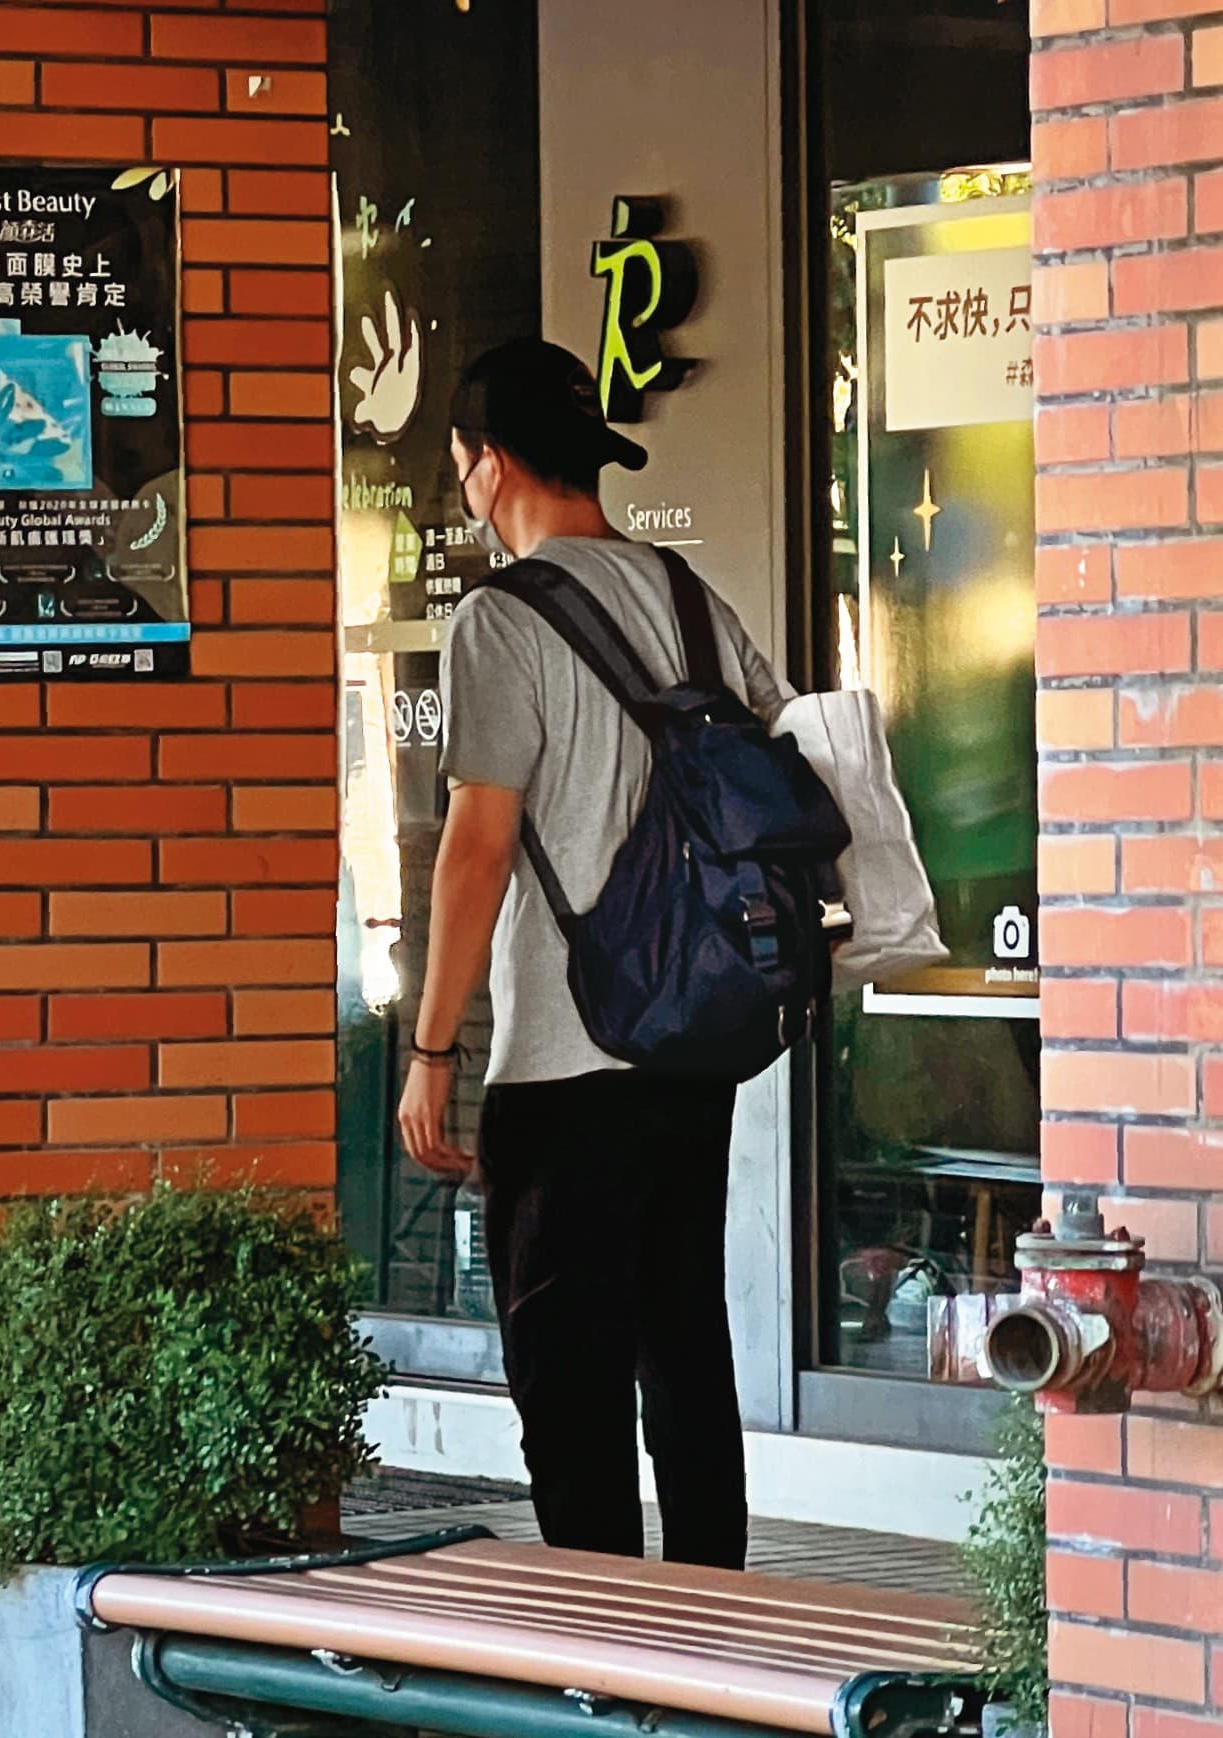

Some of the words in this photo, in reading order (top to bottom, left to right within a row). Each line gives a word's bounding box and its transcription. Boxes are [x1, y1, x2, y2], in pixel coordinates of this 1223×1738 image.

[17, 189, 97, 220] Beauty
[341, 470, 413, 510] elebration
[20, 513, 62, 527] Global
[64, 512, 111, 527] Awards
[627, 500, 692, 532] Services
